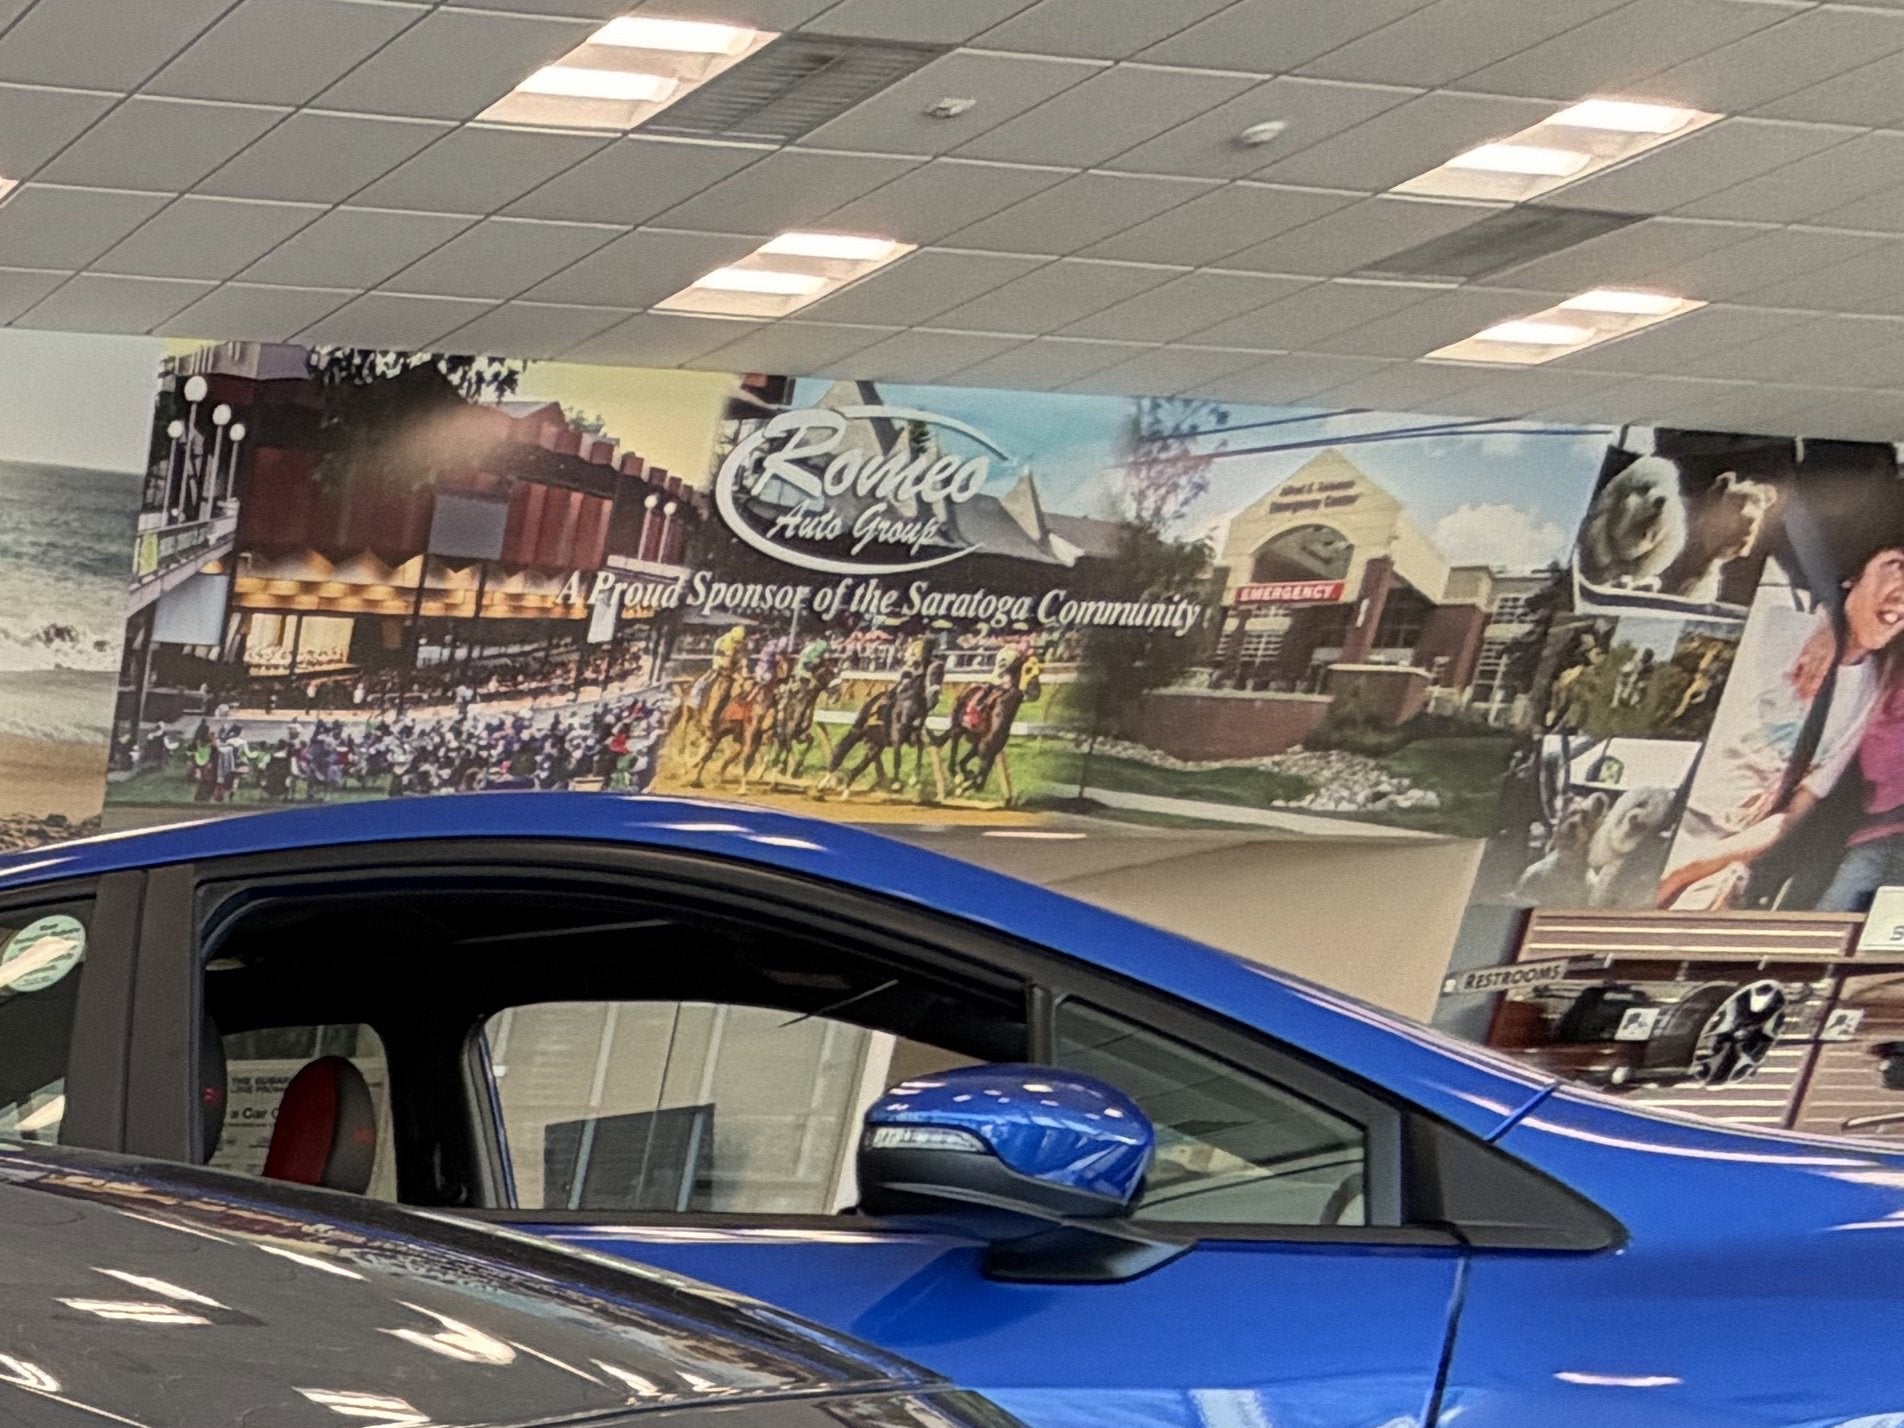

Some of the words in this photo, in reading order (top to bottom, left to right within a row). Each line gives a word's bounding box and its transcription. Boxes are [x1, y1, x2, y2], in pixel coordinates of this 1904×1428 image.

[750, 408, 989, 502] Romeo
[767, 500, 841, 540] Auto
[849, 502, 941, 556] Group
[556, 570, 581, 605] A
[588, 570, 690, 609] Proud
[687, 570, 811, 616] Sponsor
[812, 577, 853, 621] of
[852, 578, 899, 614] the
[902, 581, 1030, 628] Saratoga
[1037, 589, 1201, 637] Community
[1239, 583, 1336, 602] EMERGENCY
[1464, 965, 1561, 989] RESTROOMS
